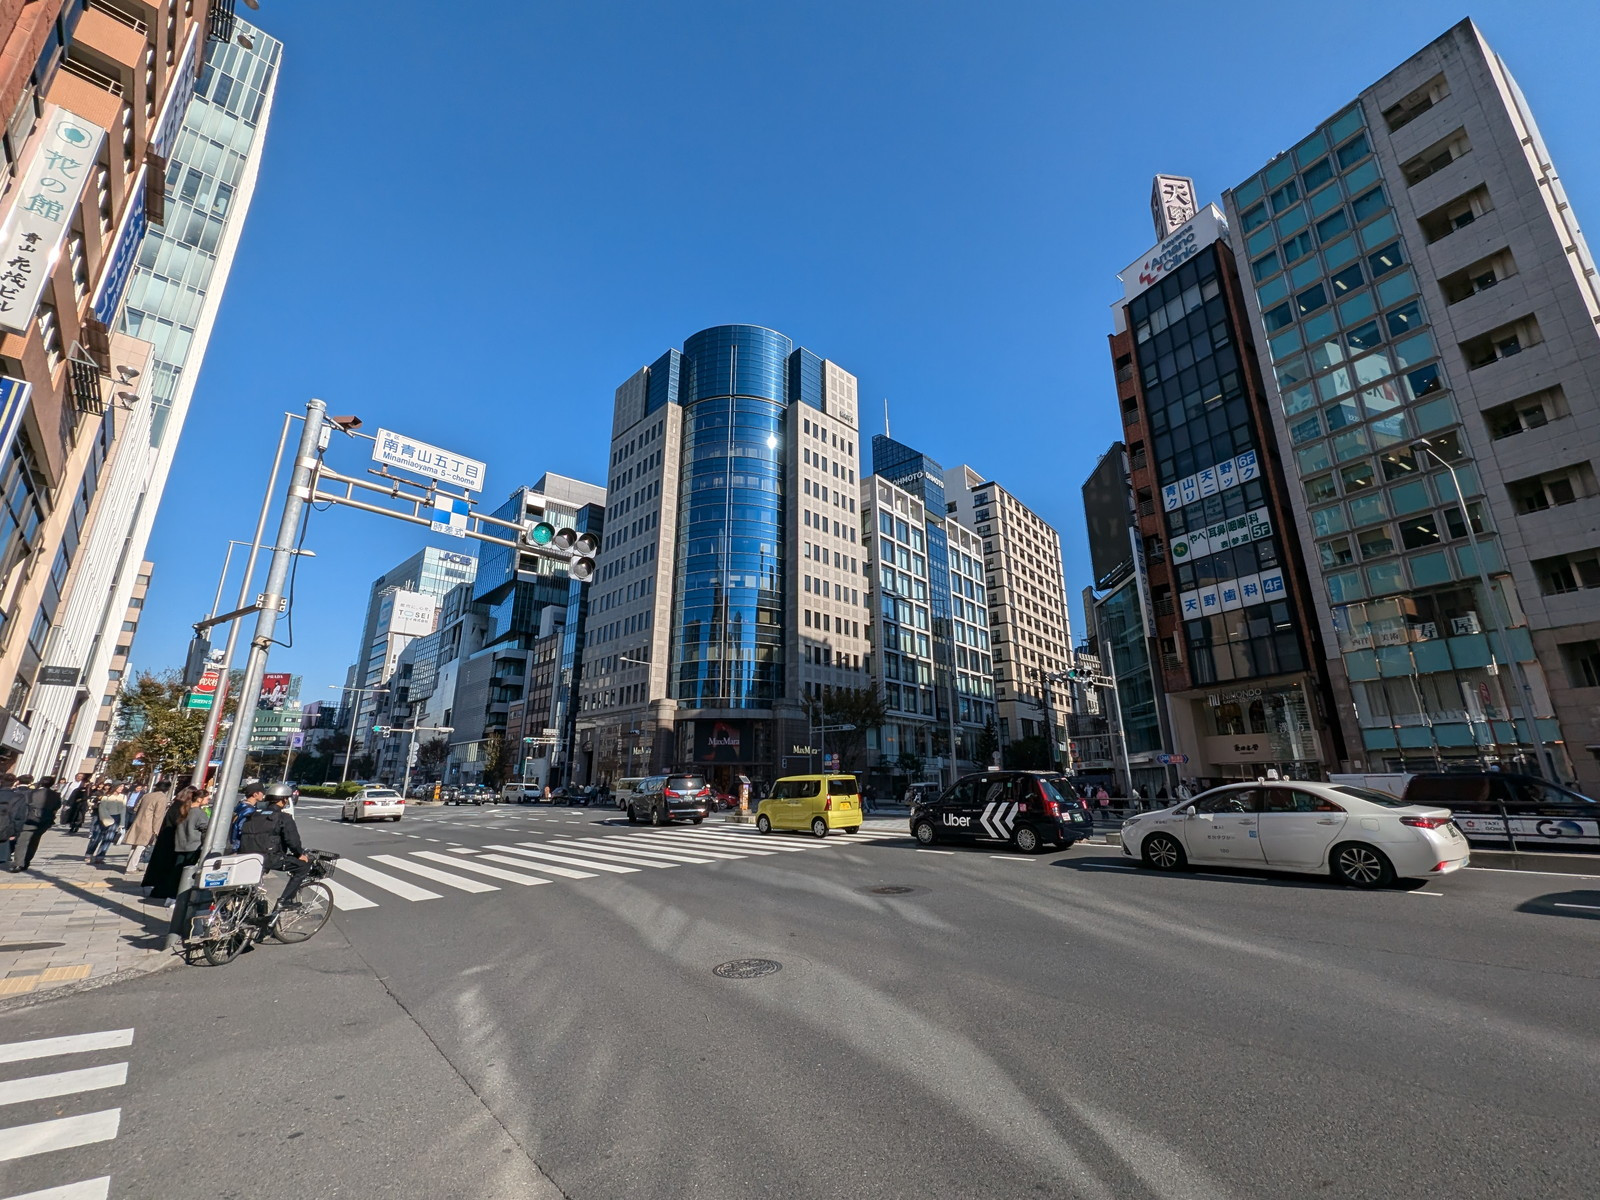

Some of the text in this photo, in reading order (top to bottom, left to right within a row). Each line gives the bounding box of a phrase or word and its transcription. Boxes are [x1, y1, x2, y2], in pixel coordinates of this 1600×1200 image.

[24, 149, 83, 223] 花の館
[1151, 233, 1195, 271] Amano
[1161, 225, 1193, 253] Aoyama
[1163, 244, 1198, 272] Clinic
[382, 451, 475, 486] Minamiaoyama 5-chome
[383, 438, 478, 479] 南青山五丁目
[1165, 454, 1254, 497] 青山天野 6F
[1168, 467, 1255, 510] クリニック
[433, 521, 464, 537] 時差式
[1189, 513, 1259, 544] やべ耳鼻咽喉科
[1221, 524, 1271, 549] 表参道 5F
[439, 552, 472, 566] JCB
[1185, 578, 1282, 612] 天野歯科 4F
[708, 737, 740, 745] MaxMara
[943, 813, 970, 827] Uber
[1536, 820, 1584, 839] GO
